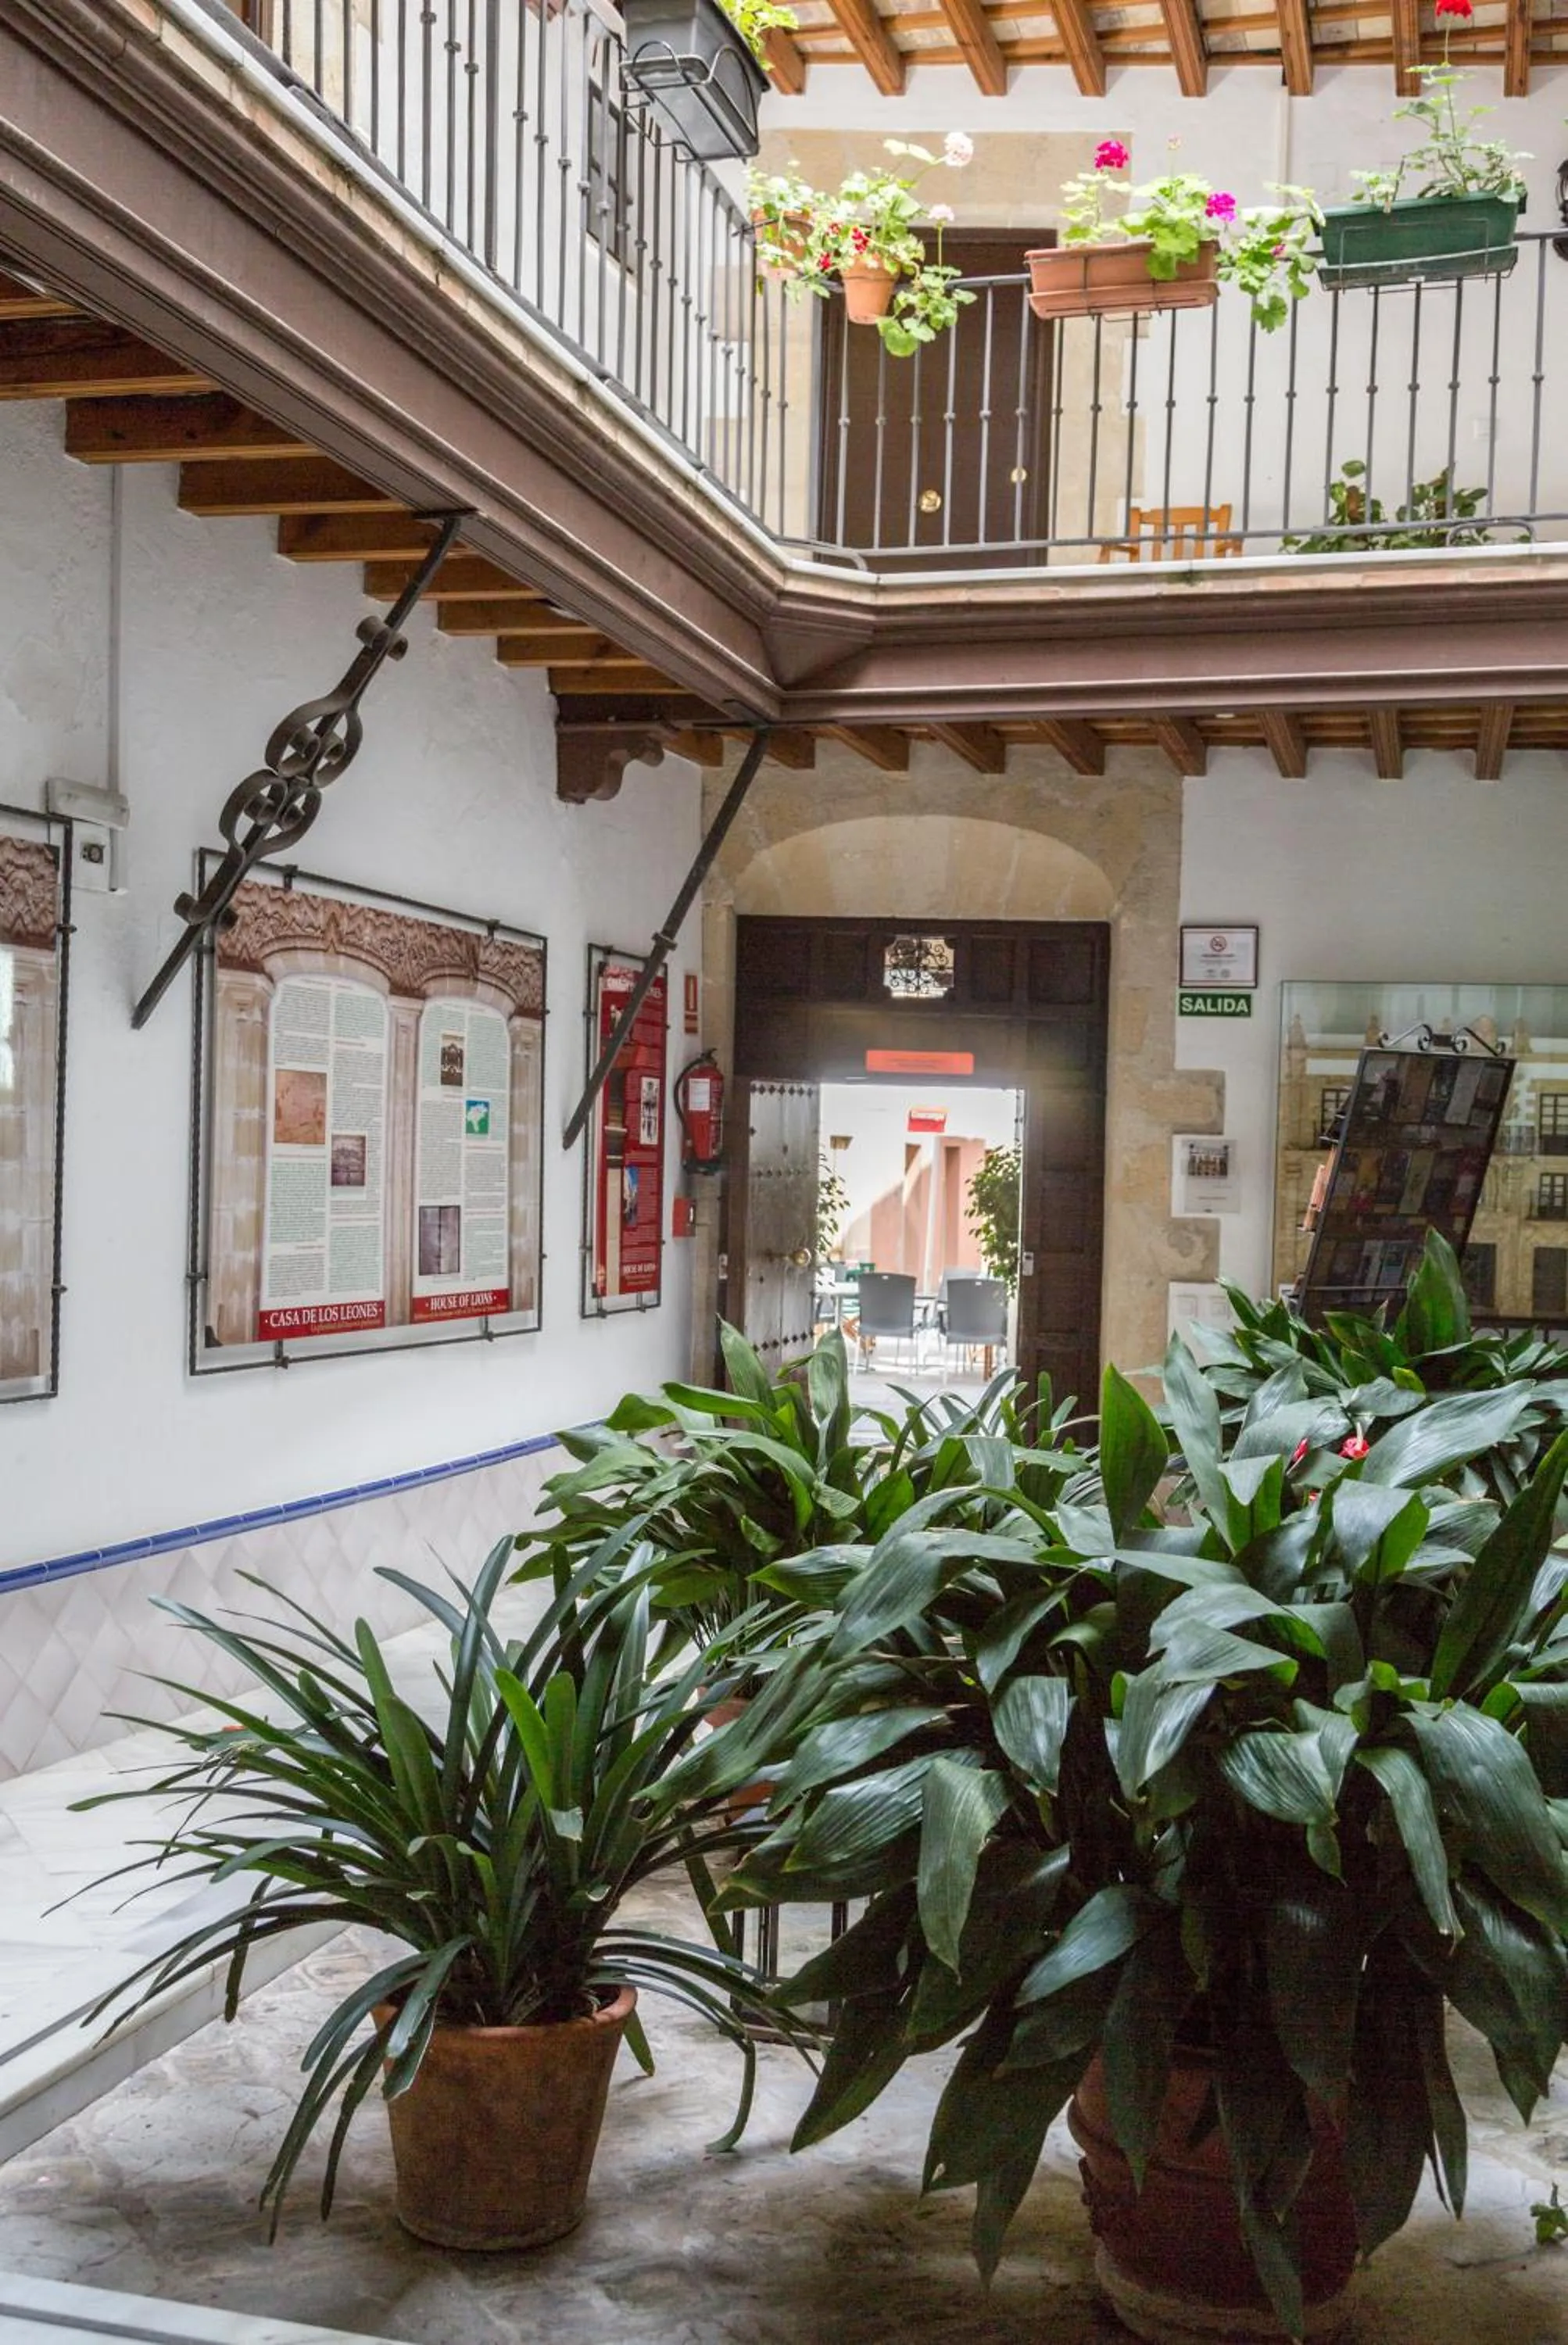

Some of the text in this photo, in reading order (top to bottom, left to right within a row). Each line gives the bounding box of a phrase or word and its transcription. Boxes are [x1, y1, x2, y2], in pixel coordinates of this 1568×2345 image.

[1182, 997, 1248, 1012] SALIDA
[431, 1296, 457, 1310] HOUSE
[458, 1294, 470, 1308] OF
[270, 1303, 378, 1326] CASA DE LOS LEONES
